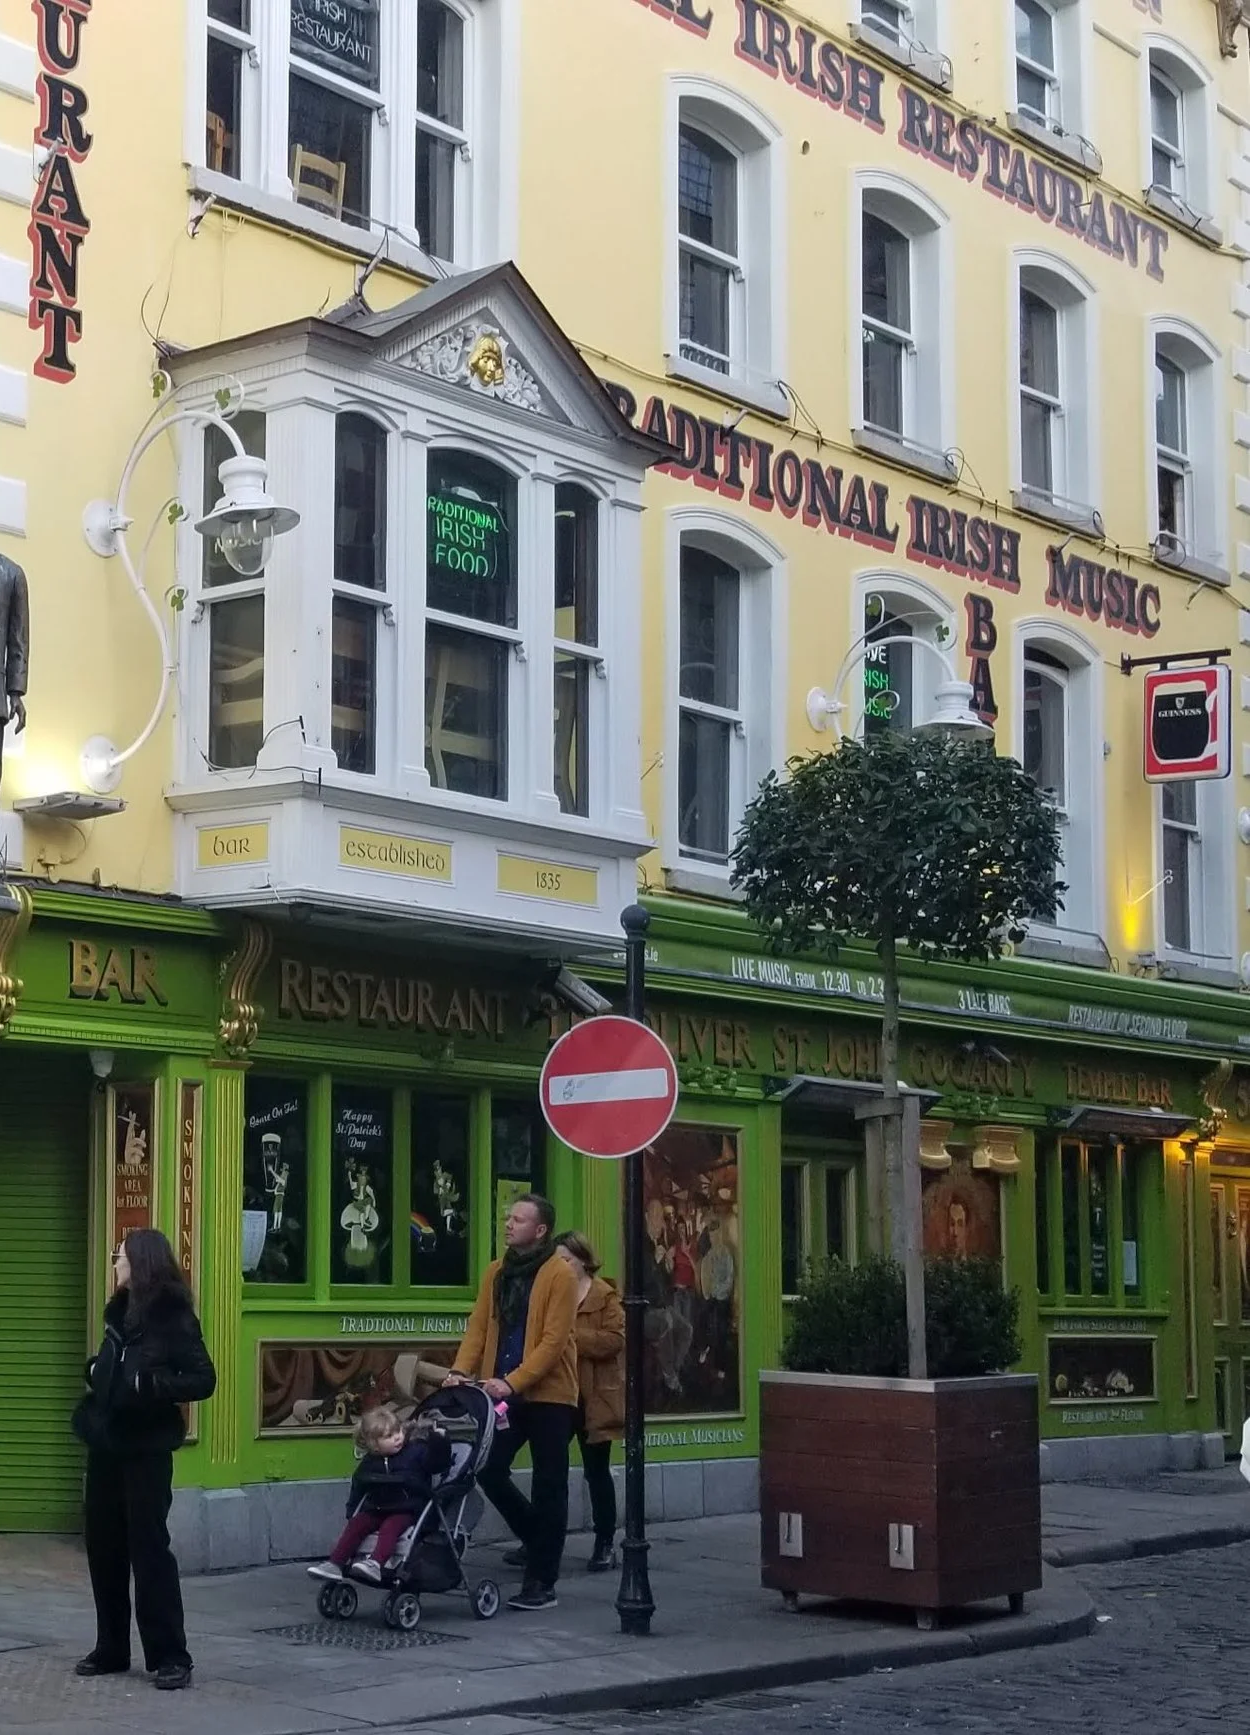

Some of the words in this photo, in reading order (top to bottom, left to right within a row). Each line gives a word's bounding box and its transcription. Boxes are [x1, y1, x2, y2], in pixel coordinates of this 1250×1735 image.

[734, 0, 885, 134] IRISH
[898, 84, 1169, 283] RESTAURANT
[29, 0, 92, 384] URANT
[427, 496, 500, 533] RADITIONAL
[602, 378, 900, 552] RADITIONAL
[905, 493, 1021, 594] IRISH
[1045, 542, 1161, 638] MUSIC
[436, 517, 486, 551] IRISH
[435, 544, 489, 577] FOOD
[964, 592, 998, 726] BA
[1158, 708, 1202, 718] GUINNESS
[535, 869, 562, 892] 1835
[69, 939, 168, 1007] BAR
[731, 957, 756, 980] LIVE
[758, 964, 791, 986] MUSIC
[822, 970, 851, 994] 12.30
[278, 958, 508, 1040] RESTAURANT
[958, 990, 965, 1010] 3
[966, 991, 987, 1013] LATE
[988, 993, 1011, 1016] BARS
[1068, 1005, 1118, 1032] RESTAURANT
[1163, 1018, 1189, 1041] FLOOR
[1136, 1071, 1174, 1108] BAR
[342, 1109, 373, 1123] Happy
[348, 1137, 367, 1151] Day
[117, 1164, 147, 1177] SMOKING
[125, 1180, 142, 1192] AREA
[126, 1196, 147, 1209] FLOOR
[183, 1120, 193, 1270] SMOKING
[422, 1316, 452, 1332] IRISH
[692, 1428, 743, 1443] MUSICIANS
